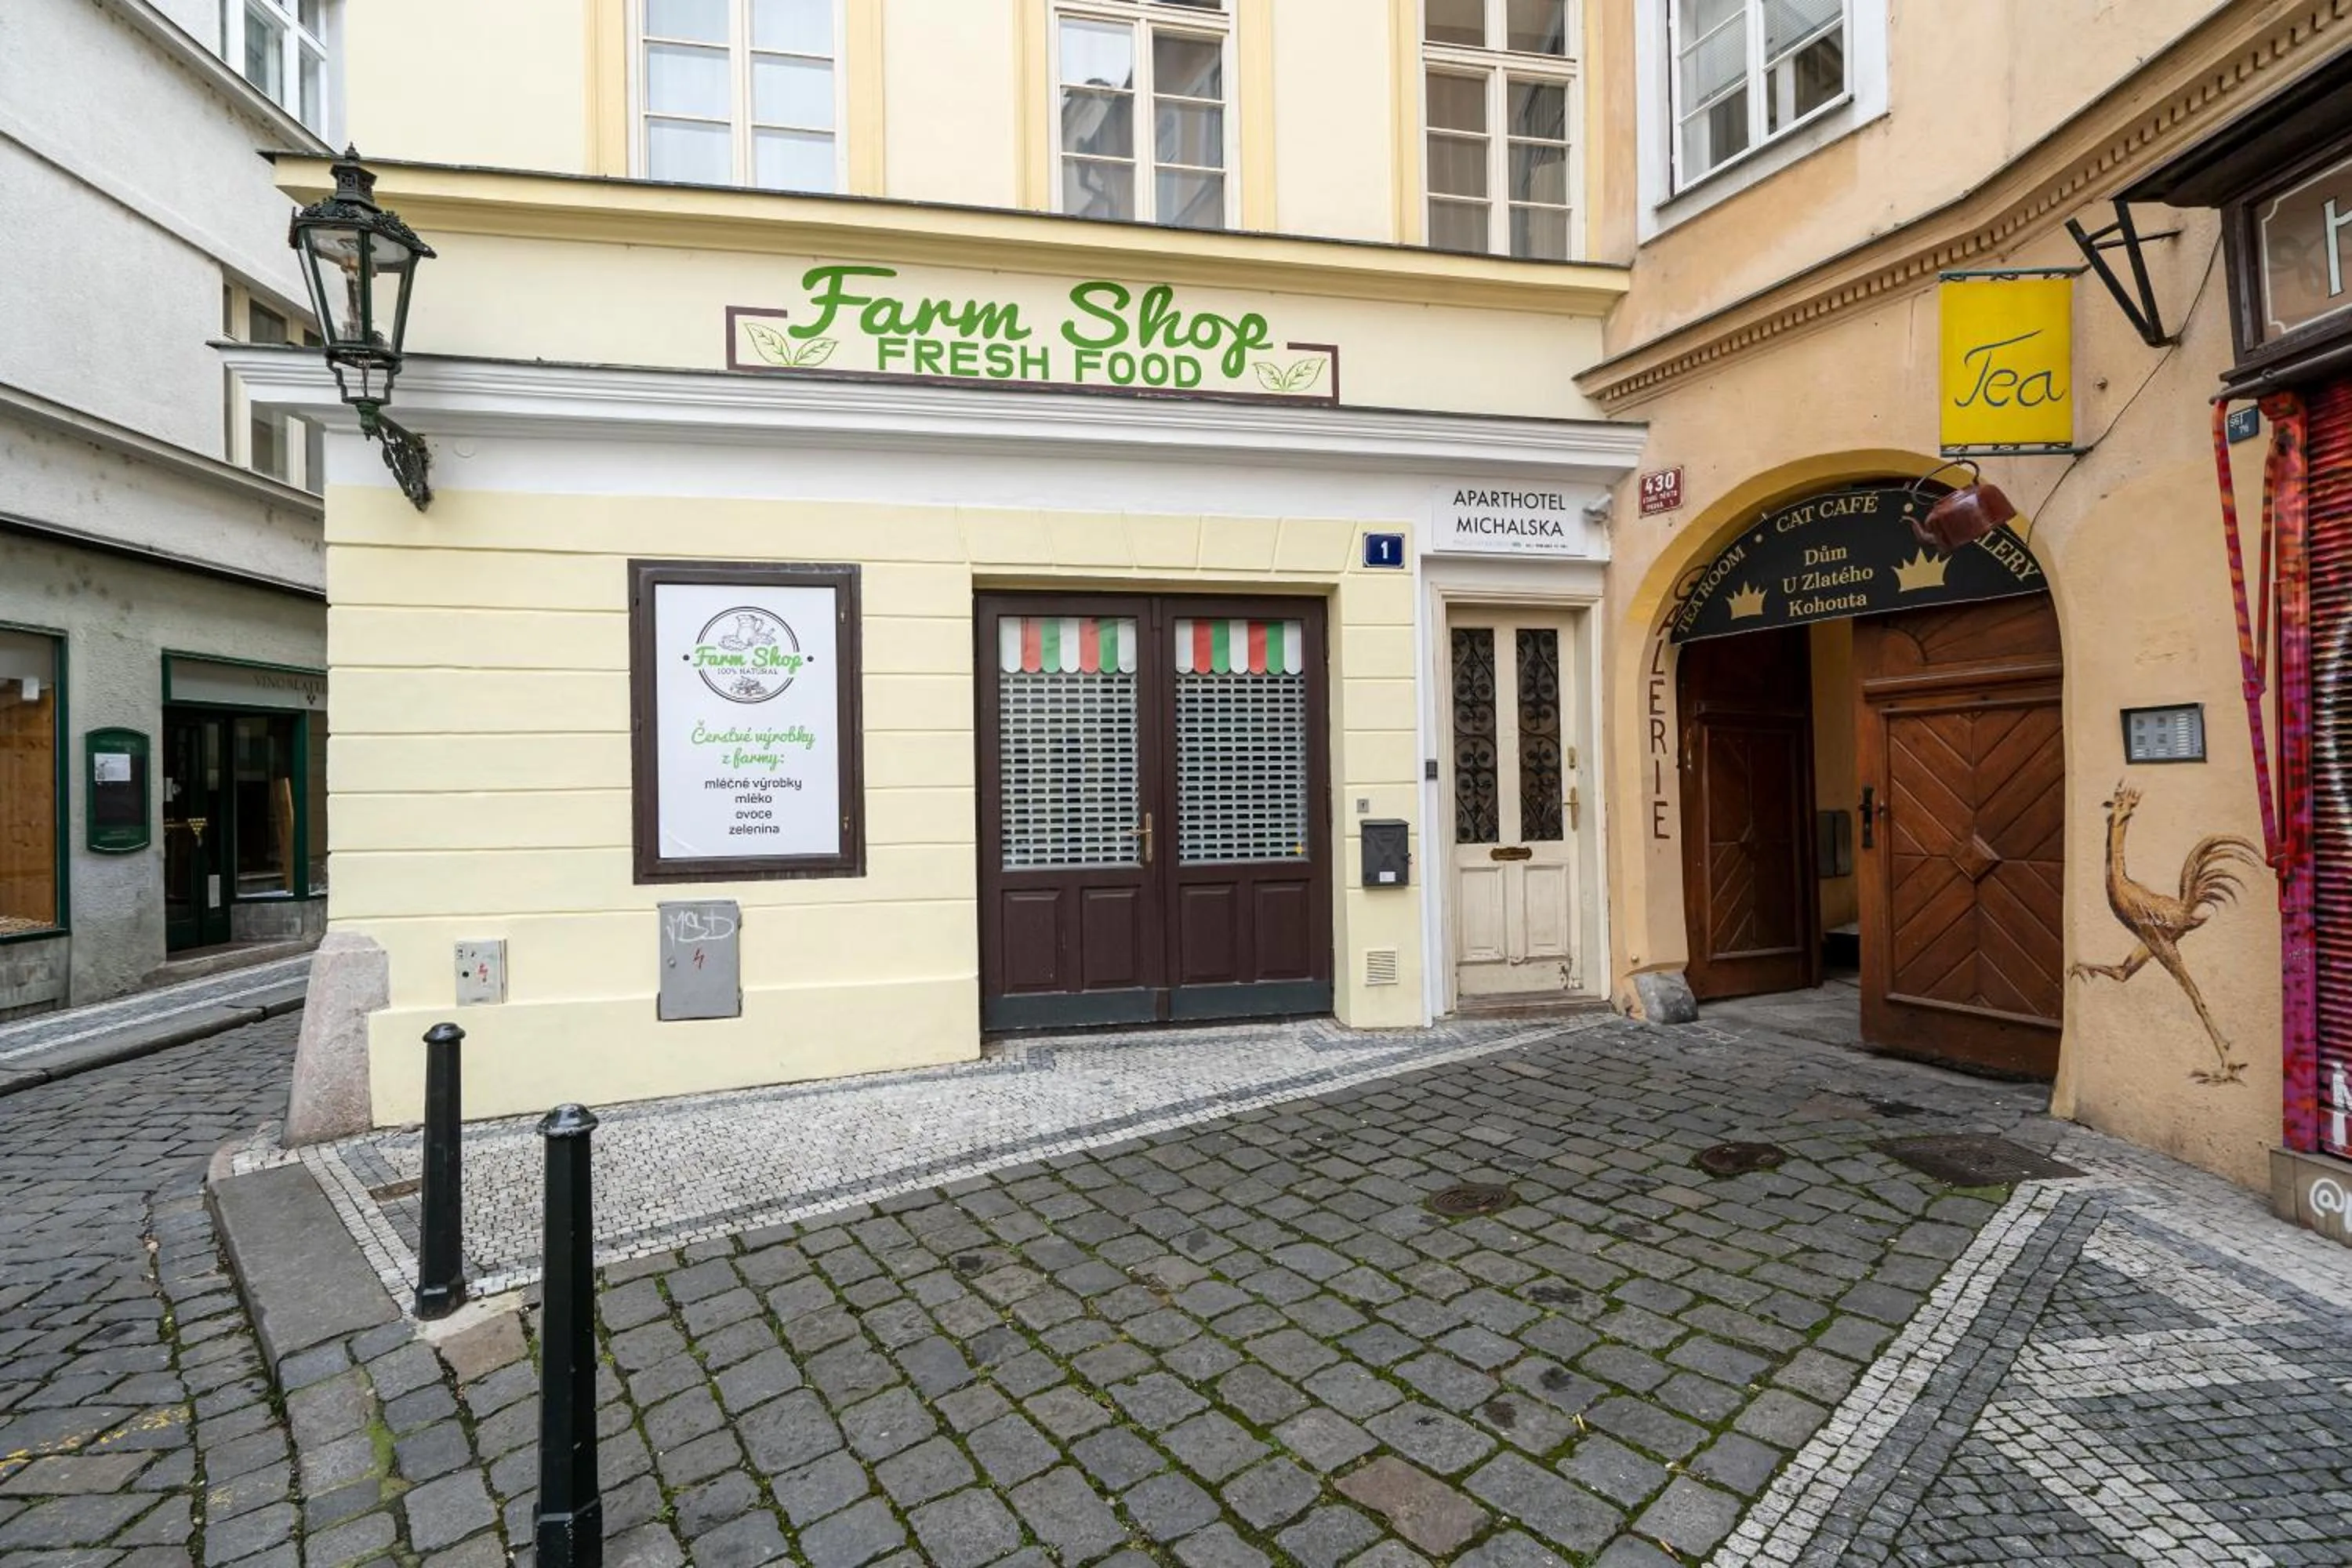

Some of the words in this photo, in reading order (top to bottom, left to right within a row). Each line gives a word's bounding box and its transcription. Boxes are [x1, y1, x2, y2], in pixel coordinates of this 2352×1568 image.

[789, 265, 1033, 339] Farm
[1061, 281, 1273, 378] Shop
[877, 337, 1050, 380] FRESH
[1074, 350, 1202, 388] FOOD
[1954, 329, 2066, 407] Tea
[1645, 471, 1675, 495] 430
[1453, 489, 1566, 510] APARTHOTEL
[1456, 516, 1564, 536] MICHALSKA
[1381, 541, 1388, 559] 1
[1701, 545, 1747, 599] ROOM
[1776, 506, 1815, 533] CAT
[1820, 492, 1879, 518] CAFÉ
[1973, 530, 2042, 583] LERY
[1805, 545, 1847, 566] Dům
[1782, 577, 1796, 594] U
[1802, 565, 1873, 590] Zlatého
[1788, 593, 1867, 617] Kohouta
[692, 646, 746, 667] Farm
[752, 646, 803, 674] Shop
[755, 725, 815, 750] výrobky
[722, 755, 731, 764] z
[733, 747, 784, 771] farmy:
[704, 777, 750, 789] mléčné
[752, 777, 802, 791] výrobky
[735, 793, 772, 804] mléko
[735, 810, 772, 819] ovoce
[728, 824, 780, 835] zelenina
